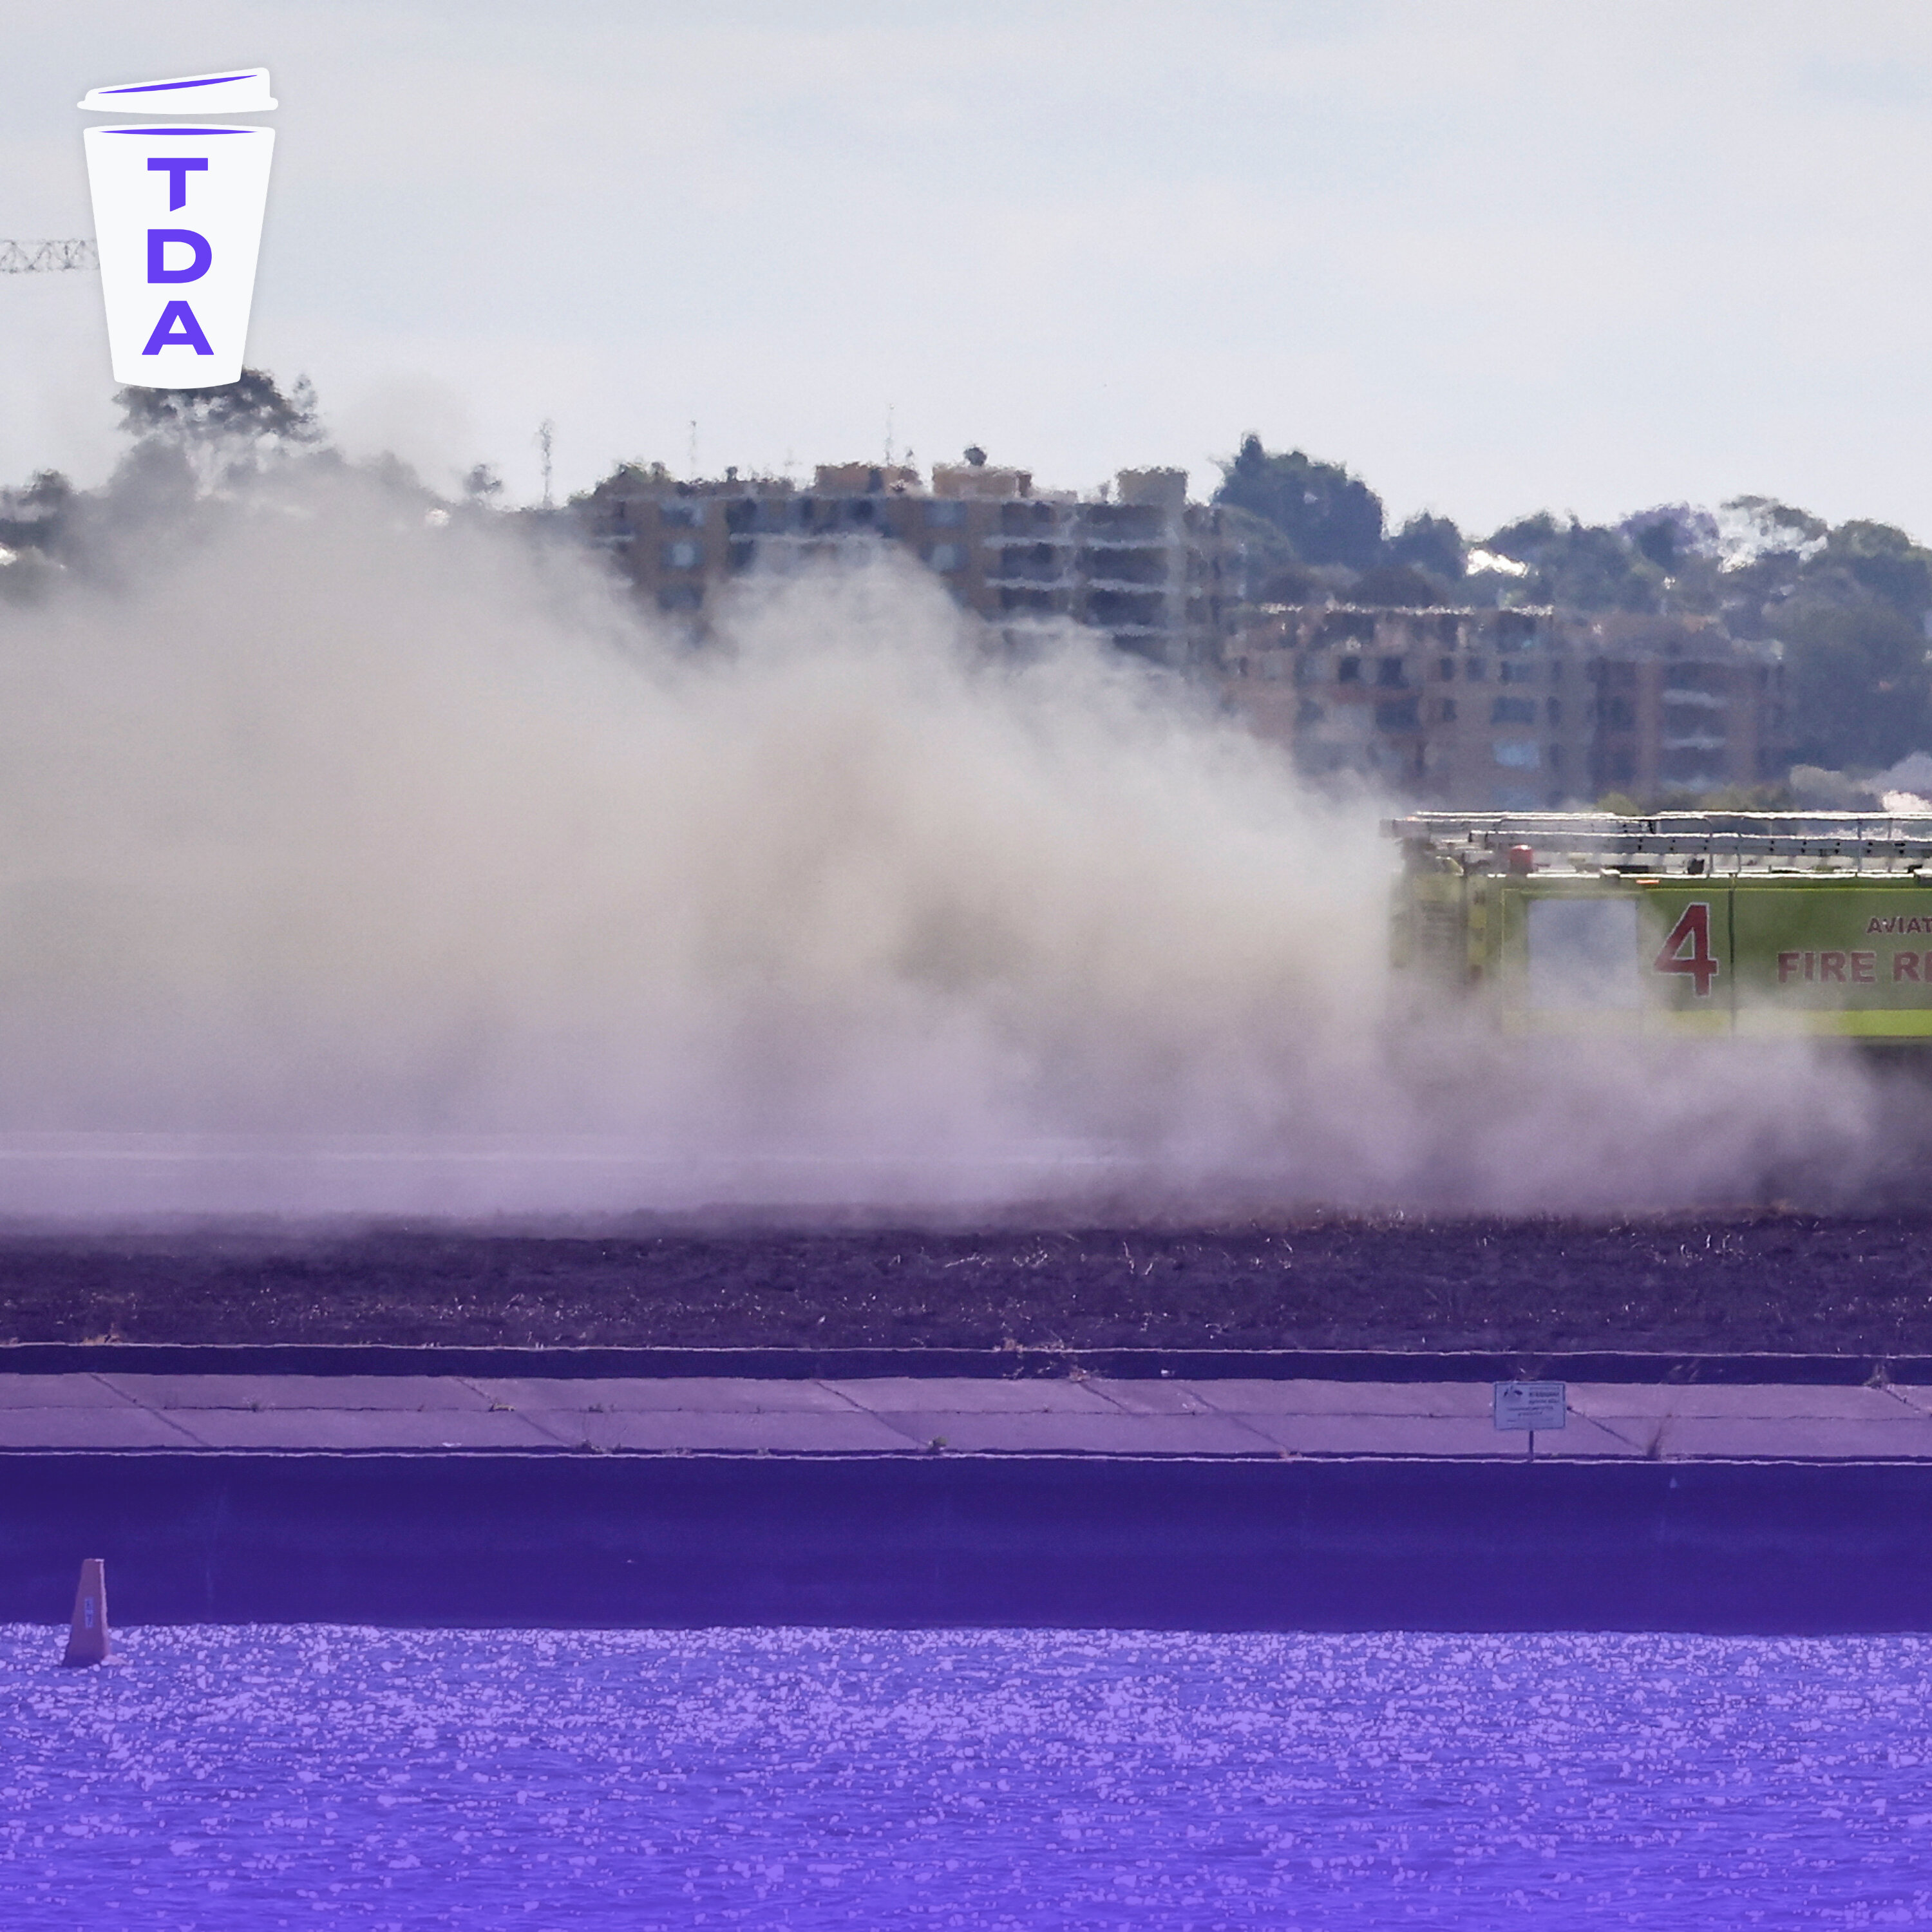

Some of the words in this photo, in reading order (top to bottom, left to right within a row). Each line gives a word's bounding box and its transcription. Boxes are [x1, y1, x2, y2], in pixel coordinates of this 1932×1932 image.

[1866, 917, 1932, 934] AVIAT
[1651, 902, 1719, 998] 4
[1777, 951, 1877, 983] FIRE
